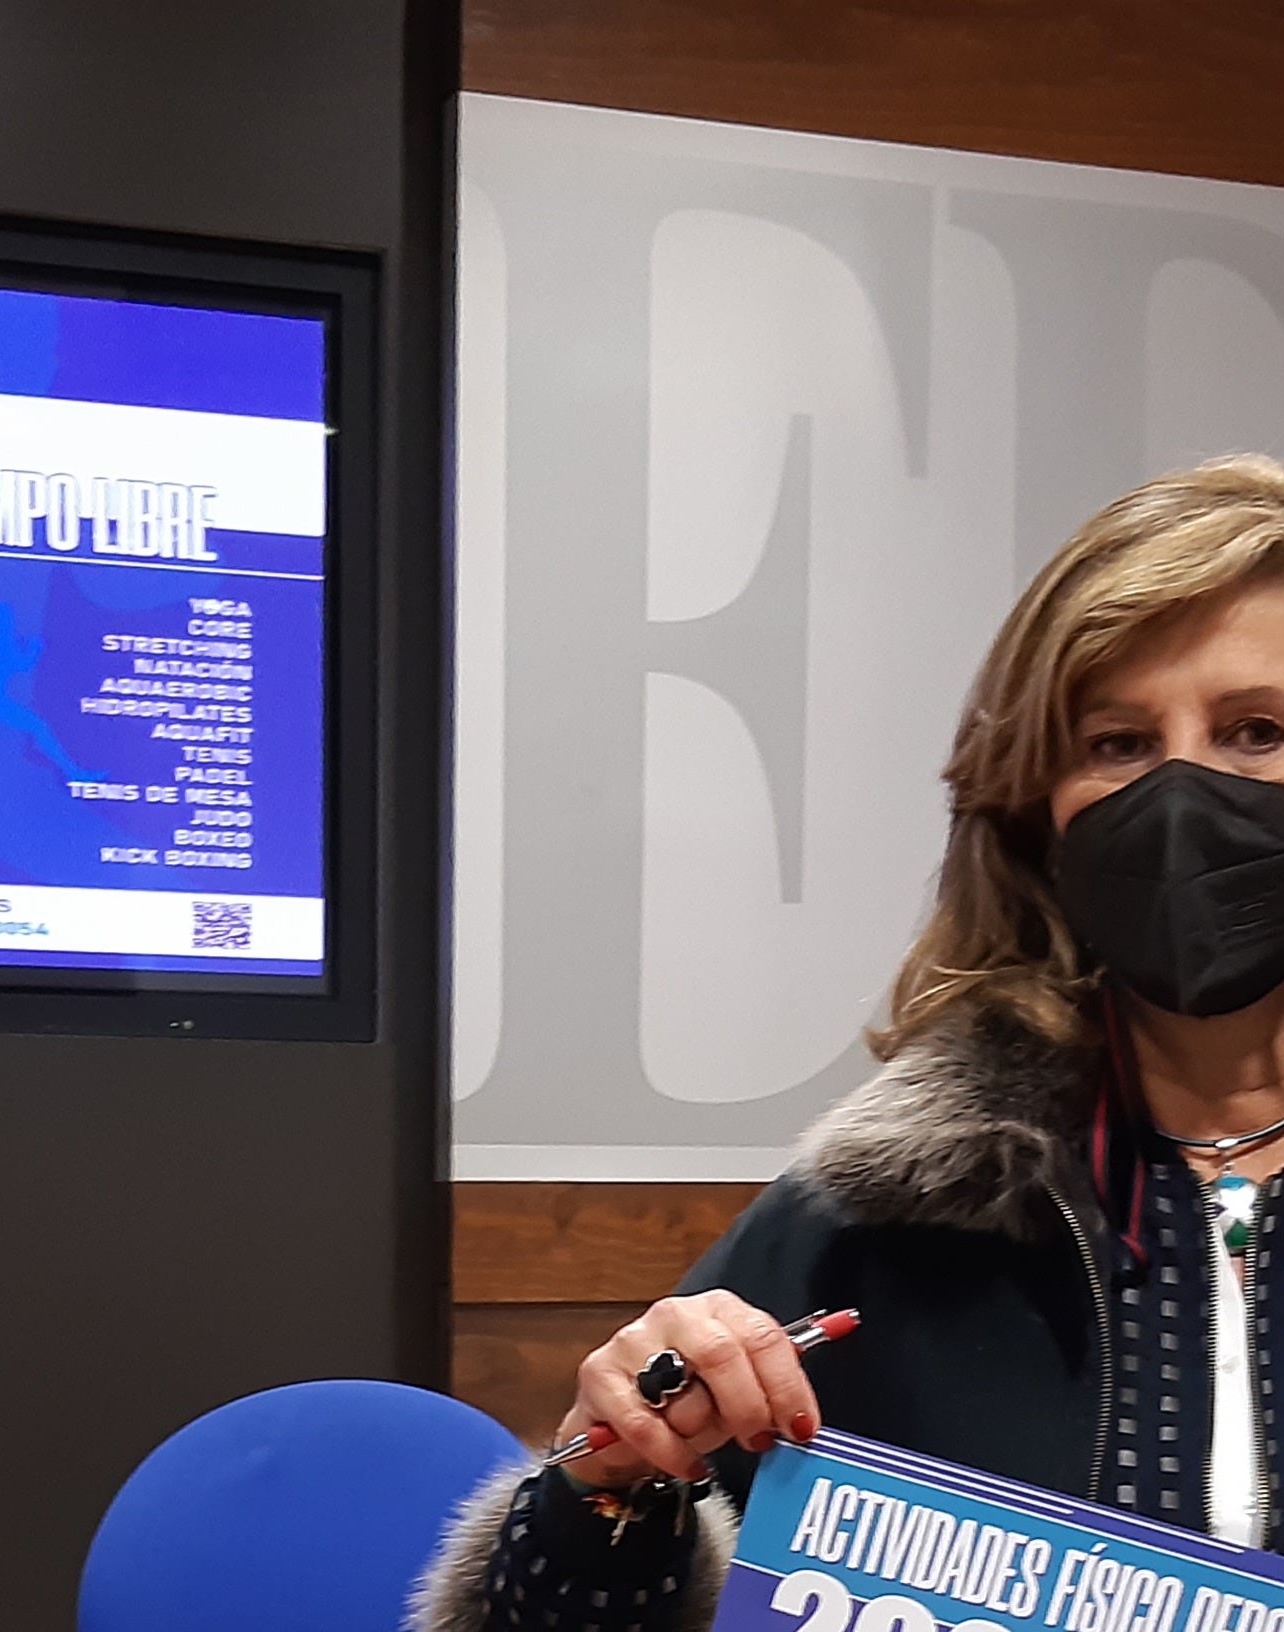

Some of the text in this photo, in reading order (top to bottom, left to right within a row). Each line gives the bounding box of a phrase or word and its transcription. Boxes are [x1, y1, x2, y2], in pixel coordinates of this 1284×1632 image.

[93, 476, 218, 561] LIBRE
[188, 598, 253, 617] YOGA
[187, 619, 253, 638] CORE
[101, 634, 252, 659] STRETCHING
[133, 658, 253, 680] NATACIÓN
[98, 678, 253, 701] AQUAEROBIC
[80, 697, 252, 722] HIDROPILATES
[150, 723, 254, 743] AQUAFIT
[181, 746, 253, 765] TENIS
[174, 766, 253, 785] PADEL
[67, 781, 253, 806] TENIS DE MESA
[189, 809, 252, 827] JUDO
[174, 829, 253, 847] BOXEO
[100, 847, 252, 869] KICK BOXING
[789, 1477, 1048, 1618] ACTIVIDADES
